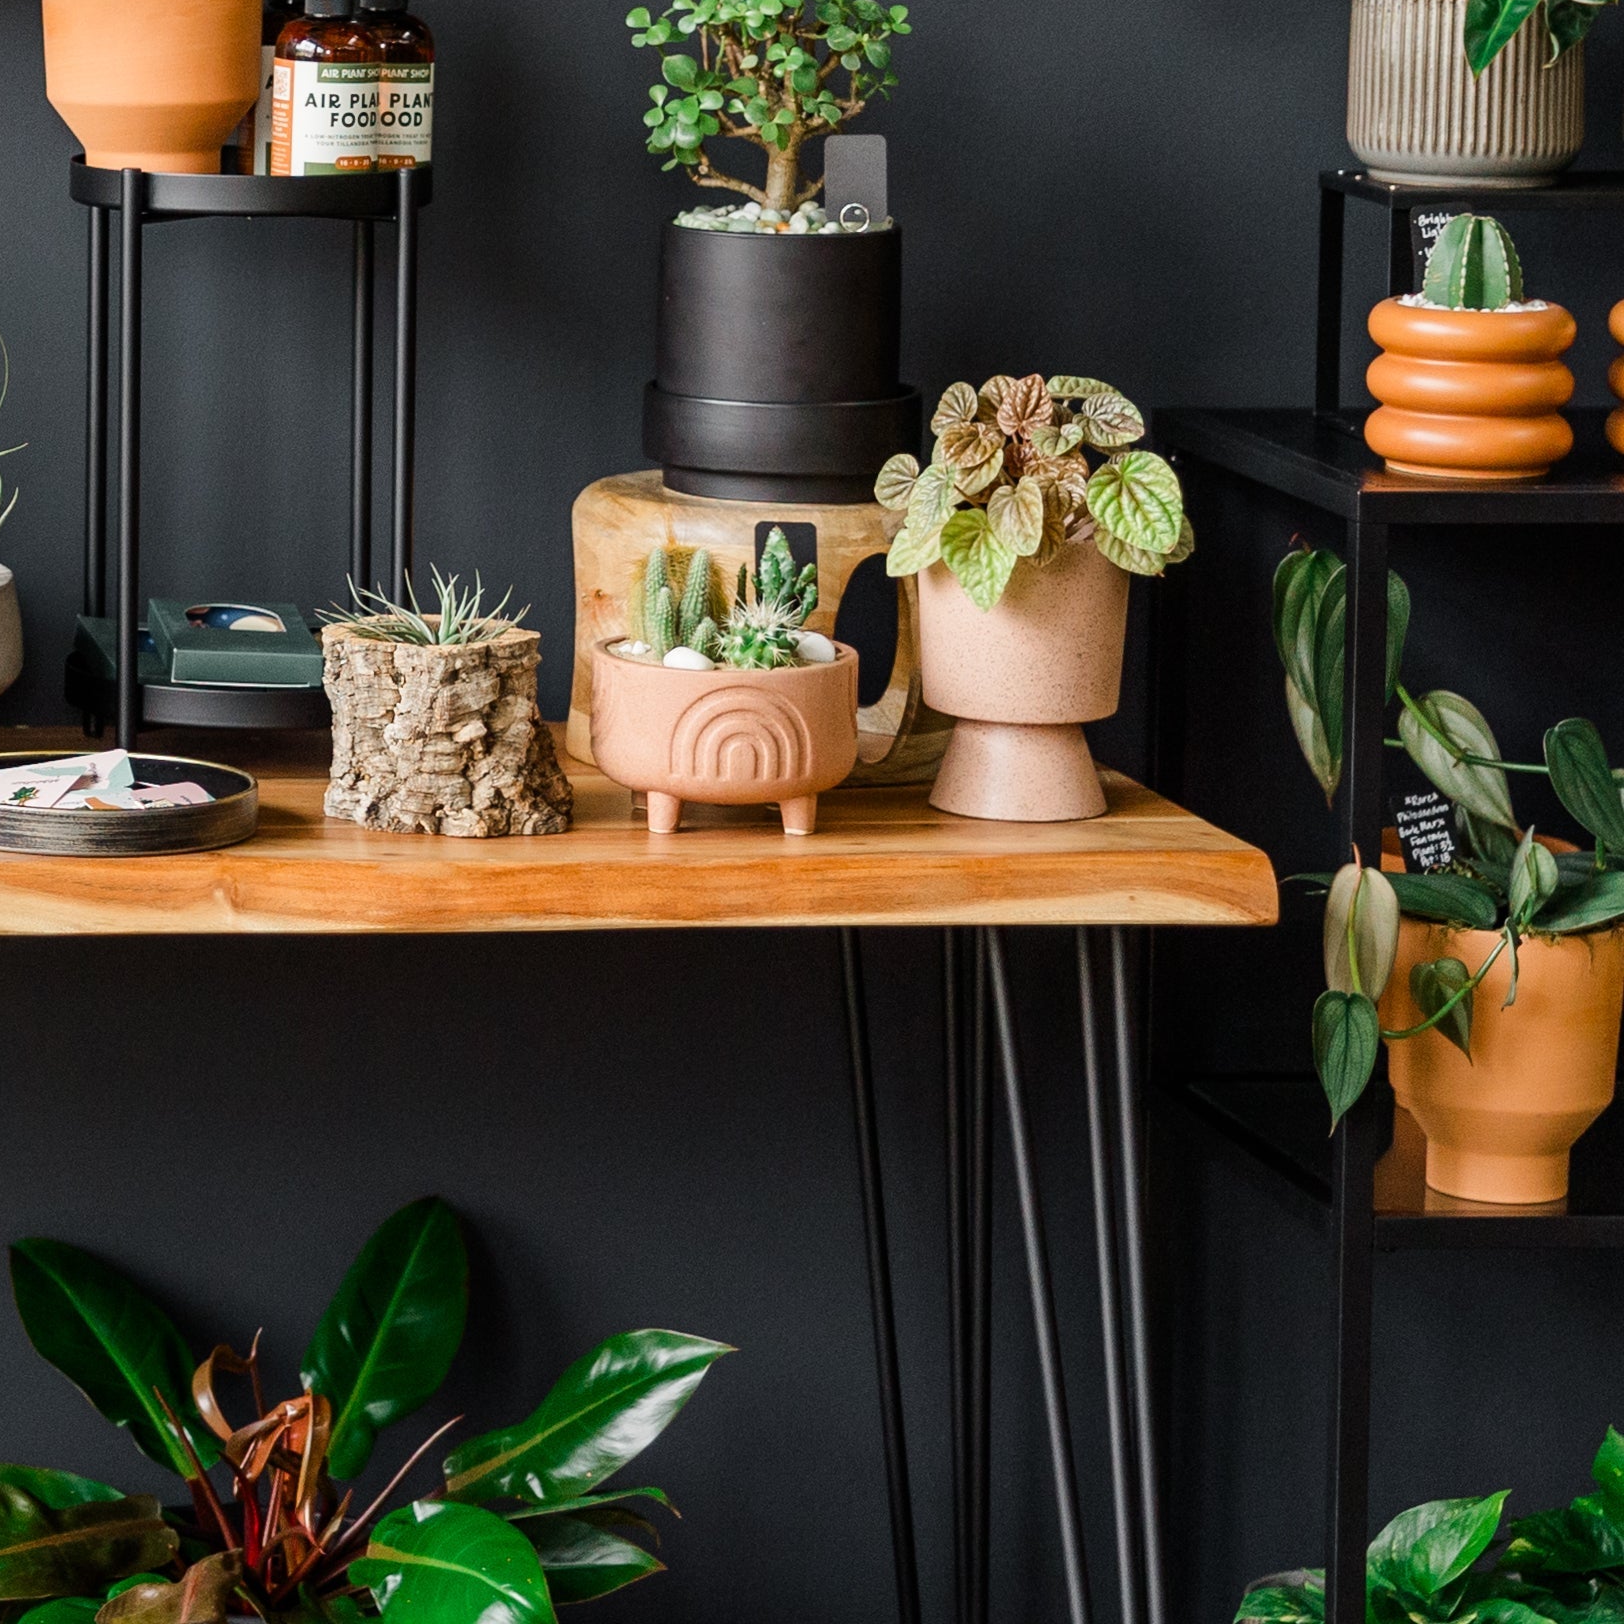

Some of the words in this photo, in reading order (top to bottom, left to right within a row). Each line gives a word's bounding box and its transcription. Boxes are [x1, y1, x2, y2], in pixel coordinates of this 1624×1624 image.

[321, 68, 340, 78] AIR
[342, 69, 366, 78] PLANT
[382, 68, 409, 78] PLANT
[305, 93, 341, 108] AIR
[331, 111, 376, 128] FOOD
[381, 111, 422, 126] OOD
